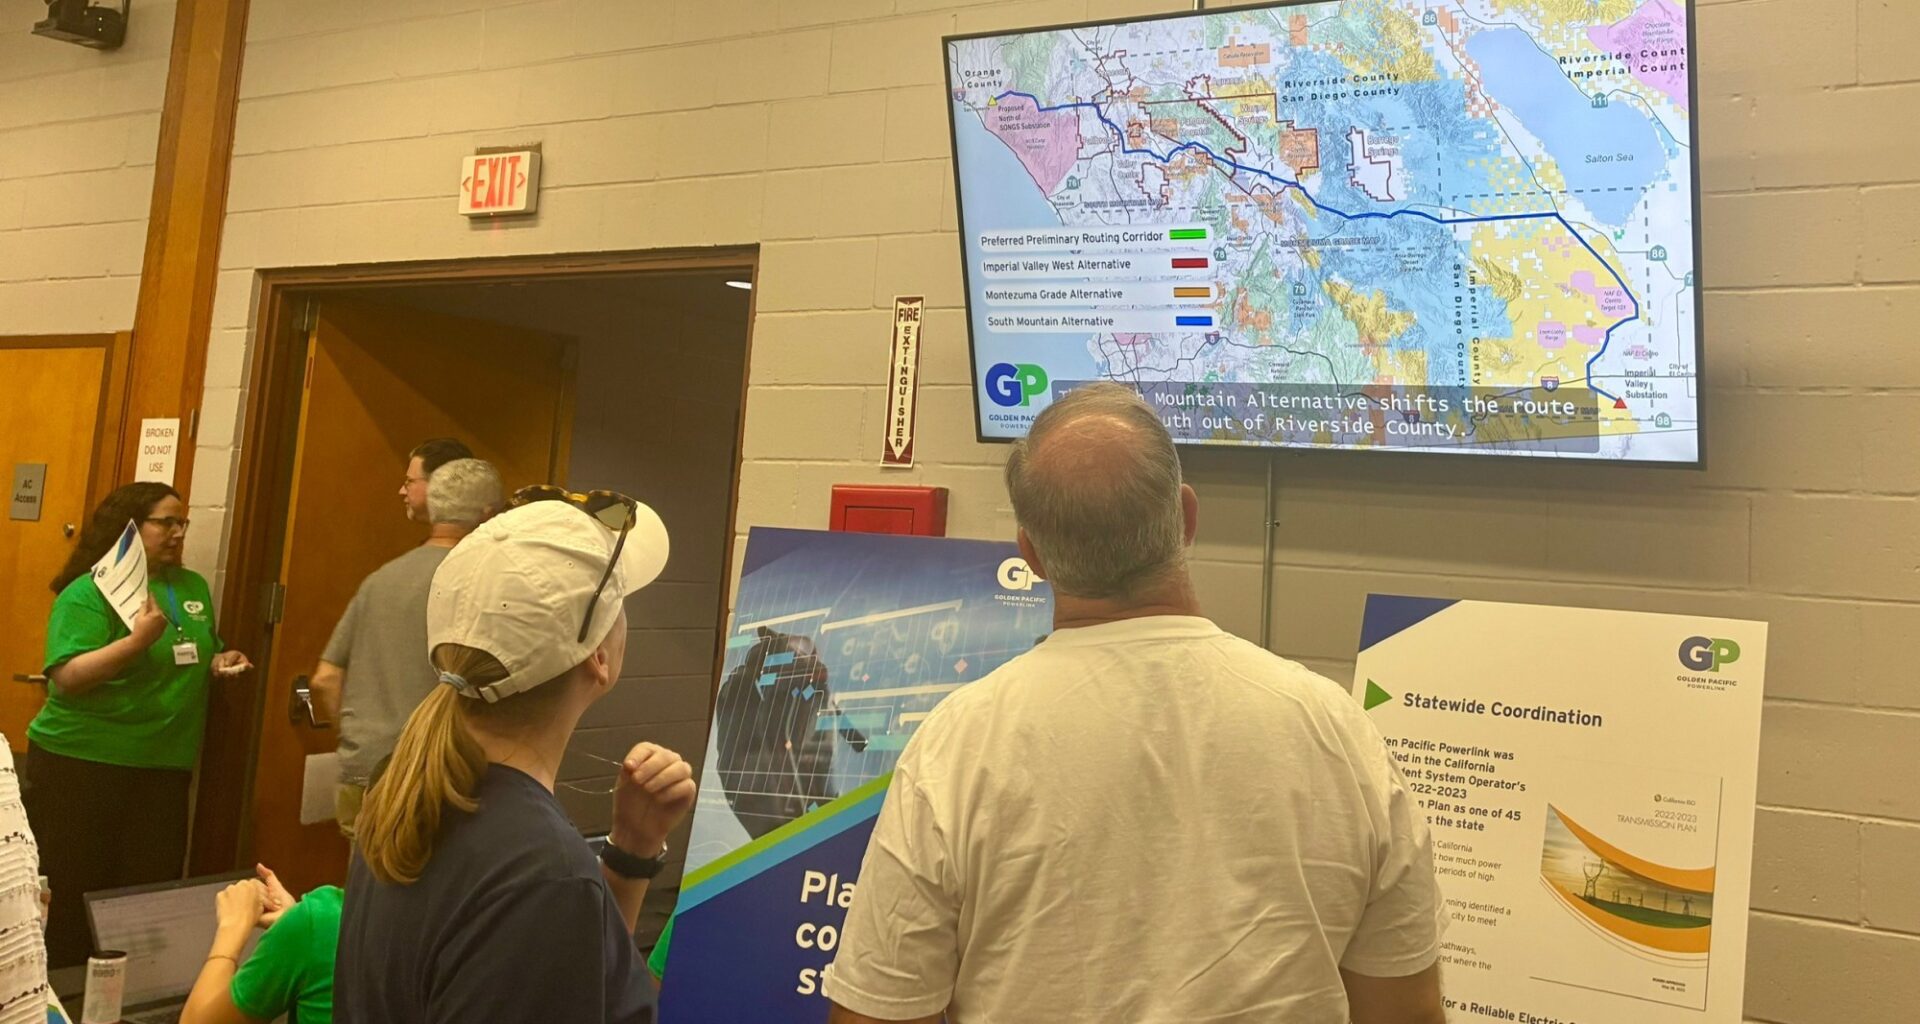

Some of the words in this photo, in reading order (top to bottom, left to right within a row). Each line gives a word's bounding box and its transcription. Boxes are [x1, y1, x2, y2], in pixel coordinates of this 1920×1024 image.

[1560, 52, 1632, 64] Riverside
[965, 68, 1001, 78] Orange
[1567, 65, 1632, 79] Imperial
[967, 80, 1003, 89] County
[1285, 77, 1346, 89] Riverside
[1353, 72, 1400, 83] County
[1282, 95, 1304, 103] San
[1311, 92, 1347, 101] Diego
[1354, 87, 1400, 97] County
[998, 105, 1024, 113] Proposed
[1021, 122, 1051, 130] Substation
[1368, 147, 1399, 157] Springs
[1585, 153, 1613, 163] Salton
[1616, 152, 1634, 162] Sea
[470, 156, 521, 208] EXIT
[981, 236, 1024, 247] Preferred
[1026, 234, 1079, 246] Preliminary
[1083, 233, 1120, 244] Routing
[1123, 231, 1163, 242] Corridor
[1651, 249, 1665, 258] 86
[983, 262, 1020, 273] Imperial
[1022, 261, 1049, 272] Valley
[1052, 260, 1074, 270] West
[1077, 259, 1131, 269] Alternative
[1453, 263, 1461, 288] San
[985, 290, 1038, 300] Montezuma
[1040, 290, 1067, 299] Grade
[1070, 289, 1123, 299] Alternative
[1468, 270, 1480, 329] Imperial
[898, 307, 920, 322] FIRE
[988, 316, 1014, 326] South
[1016, 316, 1059, 326] Mountain
[1061, 316, 1114, 326] Alternative
[1454, 296, 1462, 334] Diego
[1457, 342, 1465, 390] County
[1472, 337, 1481, 385] County
[1669, 363, 1681, 371] City
[1624, 369, 1656, 378] Imperial
[895, 326, 912, 447] EXTINGUISHER
[985, 363, 1048, 407] GP
[1625, 380, 1648, 389] Valley
[1625, 391, 1668, 399] Substation
[1155, 391, 1236, 408] Mountain
[1247, 392, 1367, 410] Alternative
[1380, 394, 1449, 412] shifts
[1462, 396, 1499, 414] the
[1513, 399, 1575, 415] route
[1162, 413, 1192, 428] uth
[1202, 415, 1232, 430] out
[1243, 416, 1265, 430] of
[1276, 416, 1375, 434] Riverside
[1386, 420, 1467, 440] County.
[1657, 416, 1670, 425] 98
[145, 427, 174, 438] BROKEN
[144, 445, 155, 455] DO
[157, 444, 171, 455] NOT
[149, 462, 164, 472] USE
[23, 479, 32, 489] AC
[14, 492, 37, 504] Access
[1021, 596, 1046, 604] PACIFIC
[1678, 636, 1740, 672] GP
[1676, 675, 1706, 684] GOLDEN
[1708, 678, 1737, 687] PACIFIC
[1687, 683, 1726, 691] POWERLINK
[1403, 692, 1485, 714] Statewide
[1491, 701, 1603, 728] Coordination
[1401, 738, 1436, 752] Pacific
[1439, 742, 1490, 758] Powerlink
[1493, 751, 1514, 760] was
[1412, 753, 1421, 764] in
[1424, 755, 1441, 766] the
[1444, 758, 1496, 773] California
[1425, 770, 1465, 784] System
[1468, 775, 1526, 792] Operator's
[1427, 799, 1451, 812] Plan
[1453, 804, 1466, 814] as
[1469, 806, 1489, 817] one
[1491, 808, 1503, 818] of
[1505, 810, 1522, 821] 45
[1655, 809, 1697, 823] 2022-2023
[1436, 816, 1453, 827] the
[1456, 819, 1485, 831] state
[1617, 814, 1675, 830] TRANSMISSION
[1677, 822, 1697, 833] PLAN
[1437, 840, 1473, 853] California
[1438, 853, 1454, 862] how
[1456, 856, 1477, 866] much
[1478, 860, 1502, 870] power
[1438, 866, 1467, 878] periods
[1468, 871, 1477, 879] of
[1478, 873, 1495, 882] high
[1469, 901, 1505, 914] identified
[1451, 912, 1466, 922] city
[1467, 914, 1476, 923] to
[1477, 916, 1497, 926] meet
[795, 922, 838, 951] co
[1453, 957, 1477, 968] where
[1479, 961, 1492, 970] the
[1441, 996, 1457, 1008] for
[1460, 1003, 1467, 1011] a
[1470, 1002, 1515, 1021] Reliable
